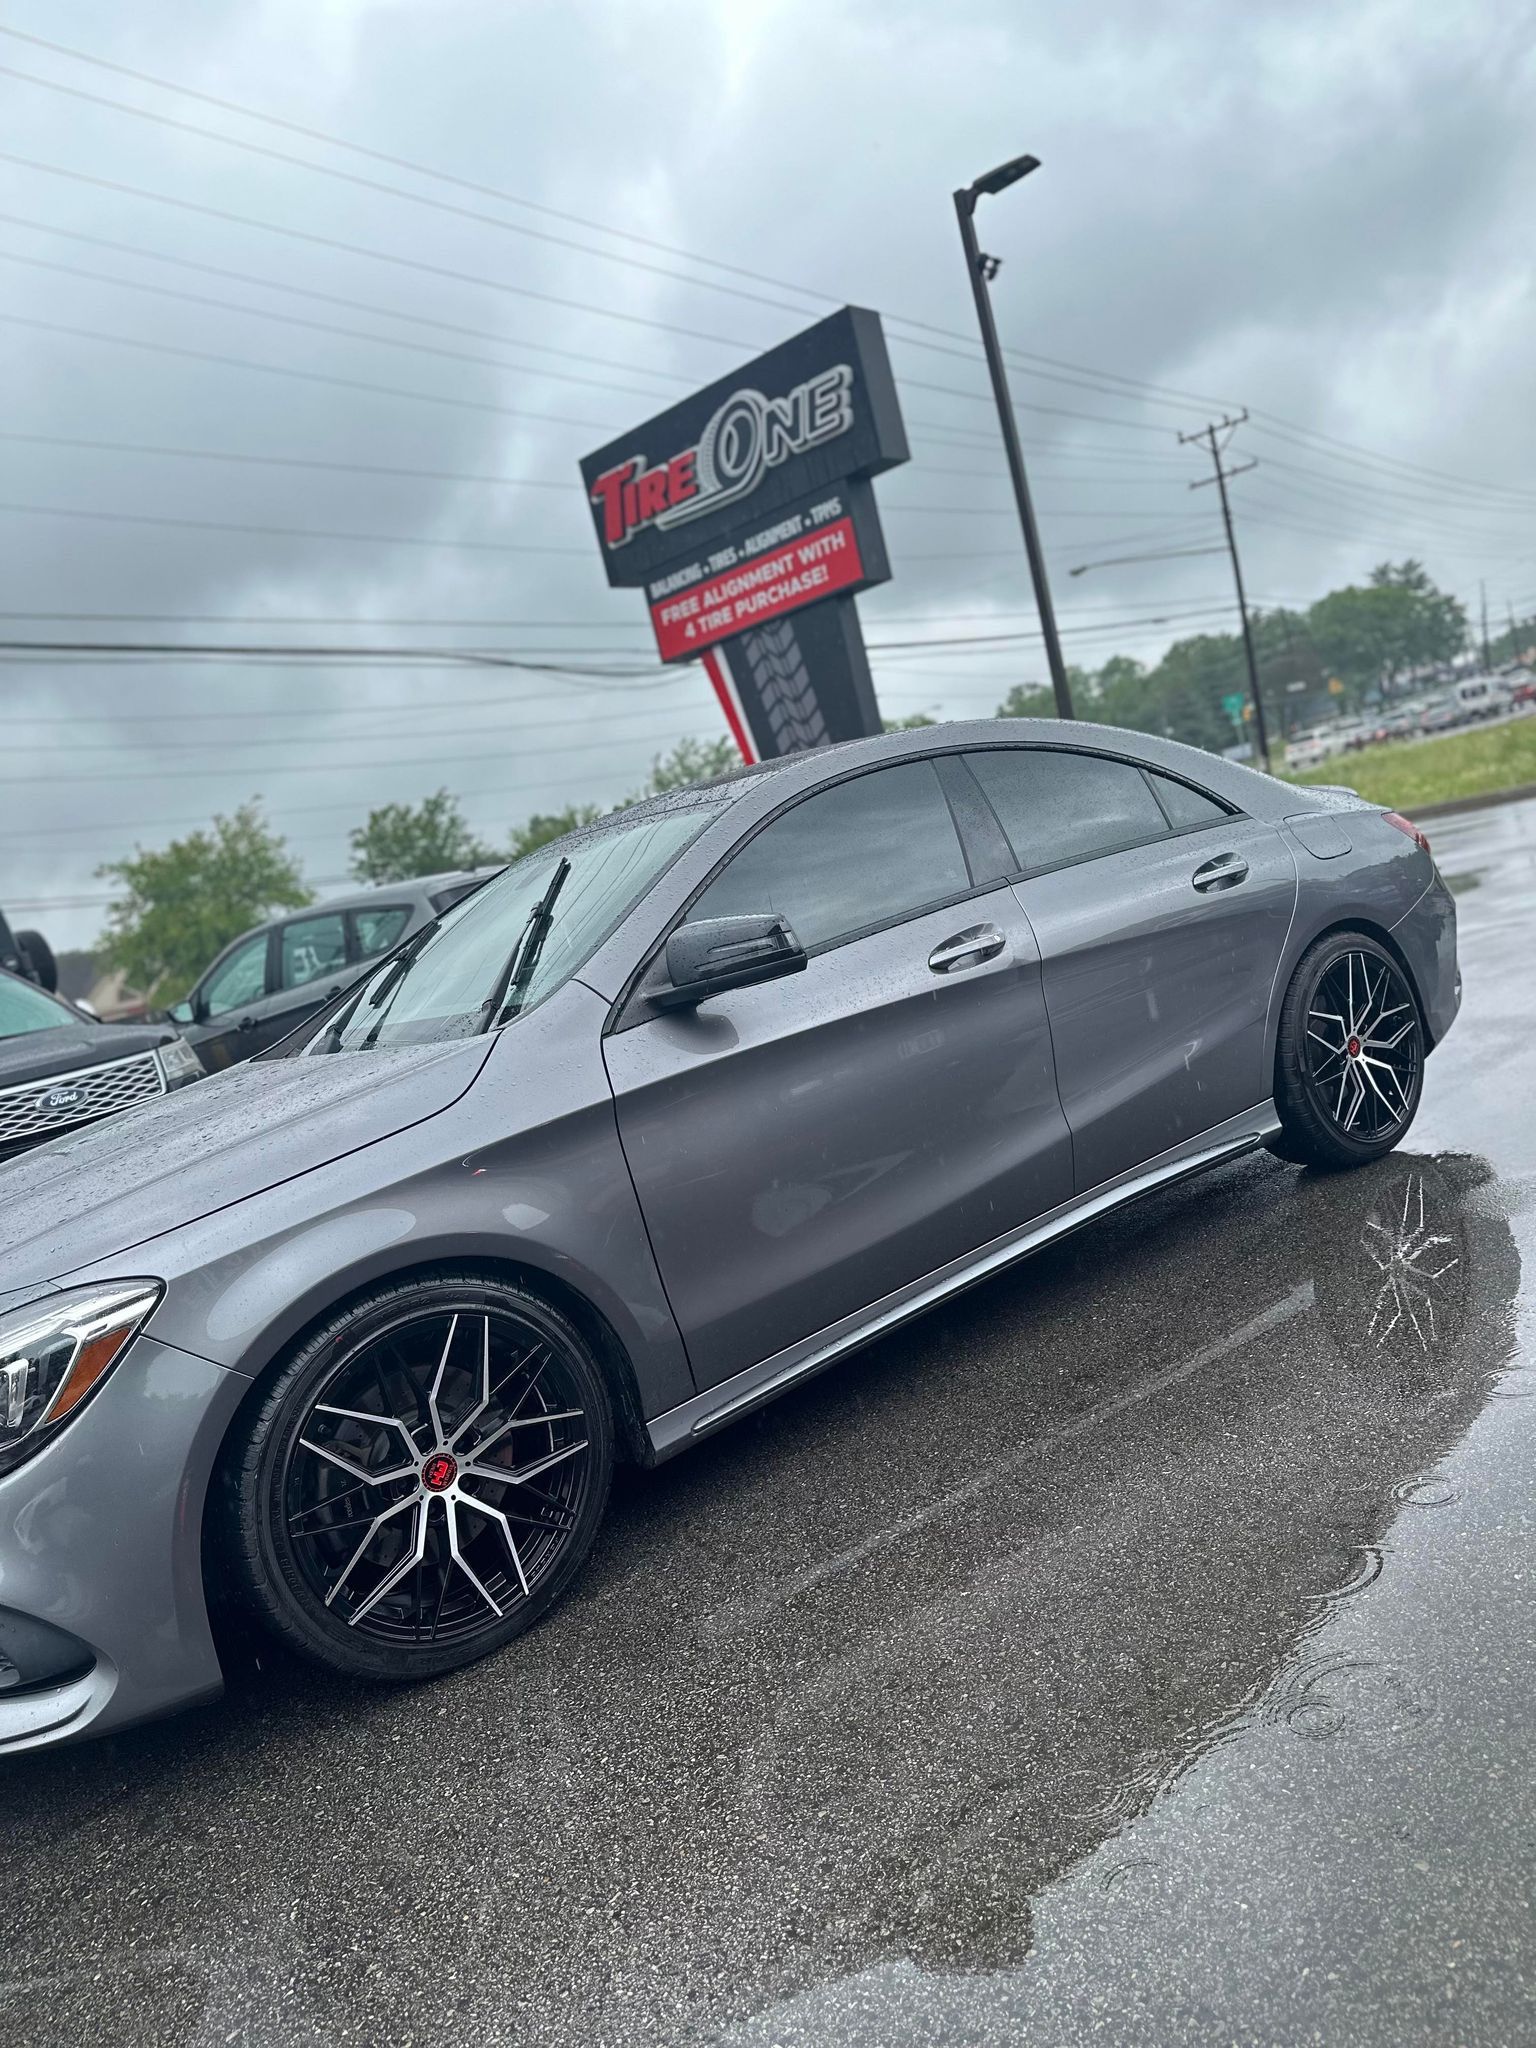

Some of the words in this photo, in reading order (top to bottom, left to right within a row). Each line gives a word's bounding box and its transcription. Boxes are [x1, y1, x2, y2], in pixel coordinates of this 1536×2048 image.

[590, 450, 699, 545] TIRE
[704, 364, 854, 490] ONE
[660, 595, 700, 626] FREE
[703, 553, 794, 608] ALIGNMENT
[797, 530, 846, 565] WITH
[707, 546, 738, 572] TIRES
[744, 514, 803, 556] ALIGNMENT
[684, 622, 696, 638] 4
[697, 605, 734, 633] TIRE
[735, 564, 829, 618] PURCHASE!
[50, 1091, 78, 1106] Ford
